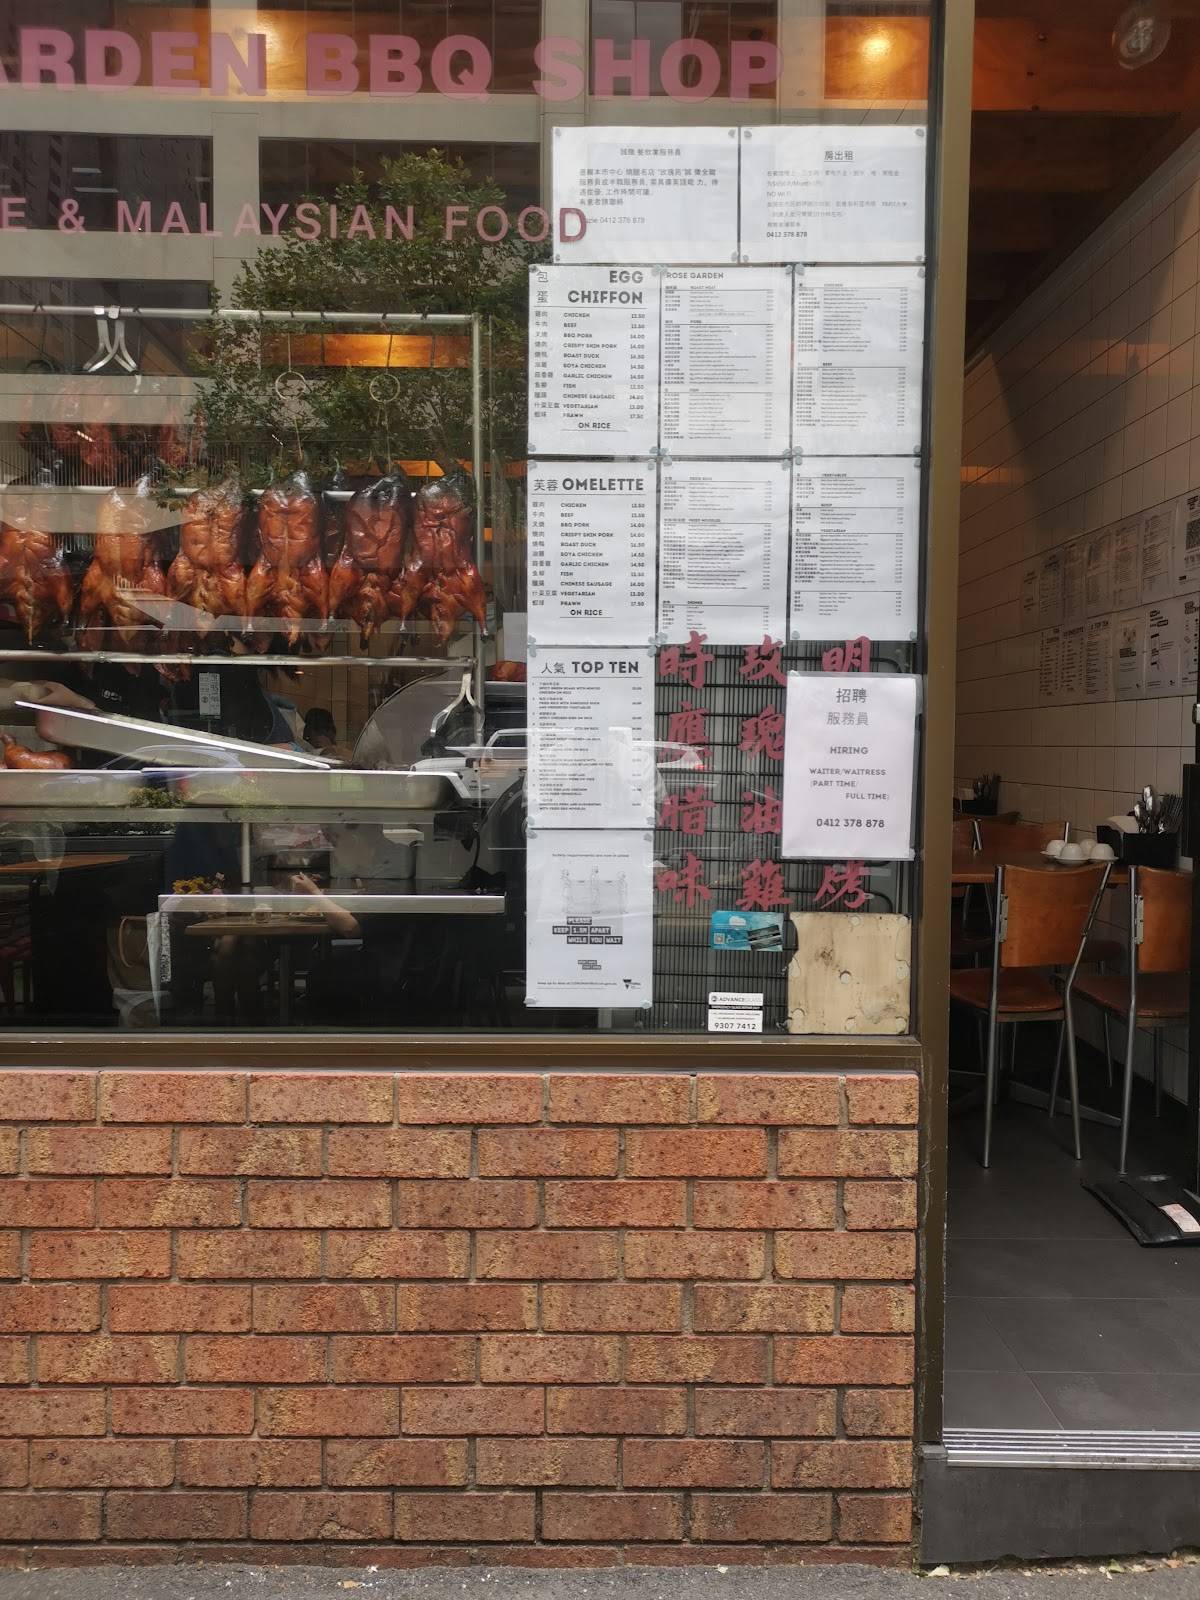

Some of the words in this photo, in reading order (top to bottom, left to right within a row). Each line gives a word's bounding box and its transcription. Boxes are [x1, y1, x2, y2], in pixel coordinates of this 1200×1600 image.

[0, 26, 265, 97] RDEN
[305, 33, 493, 101] BBQ
[533, 37, 783, 103] SHOP
[58, 198, 86, 234] &
[117, 200, 414, 241] MALAYSIAN
[445, 206, 588, 244] FOOD
[610, 271, 643, 283] EGG
[568, 291, 642, 303] CHIFFON
[534, 480, 558, 491] 芙蓉
[562, 478, 644, 491] OMELETTE
[541, 663, 565, 674] 人氣
[572, 662, 603, 673] TOP
[609, 662, 638, 673] TEN
[836, 688, 867, 703] 招聘
[827, 712, 869, 725] 服務員
[817, 819, 840, 827] 0412
[844, 819, 862, 827] 378
[866, 820, 884, 828] 878
